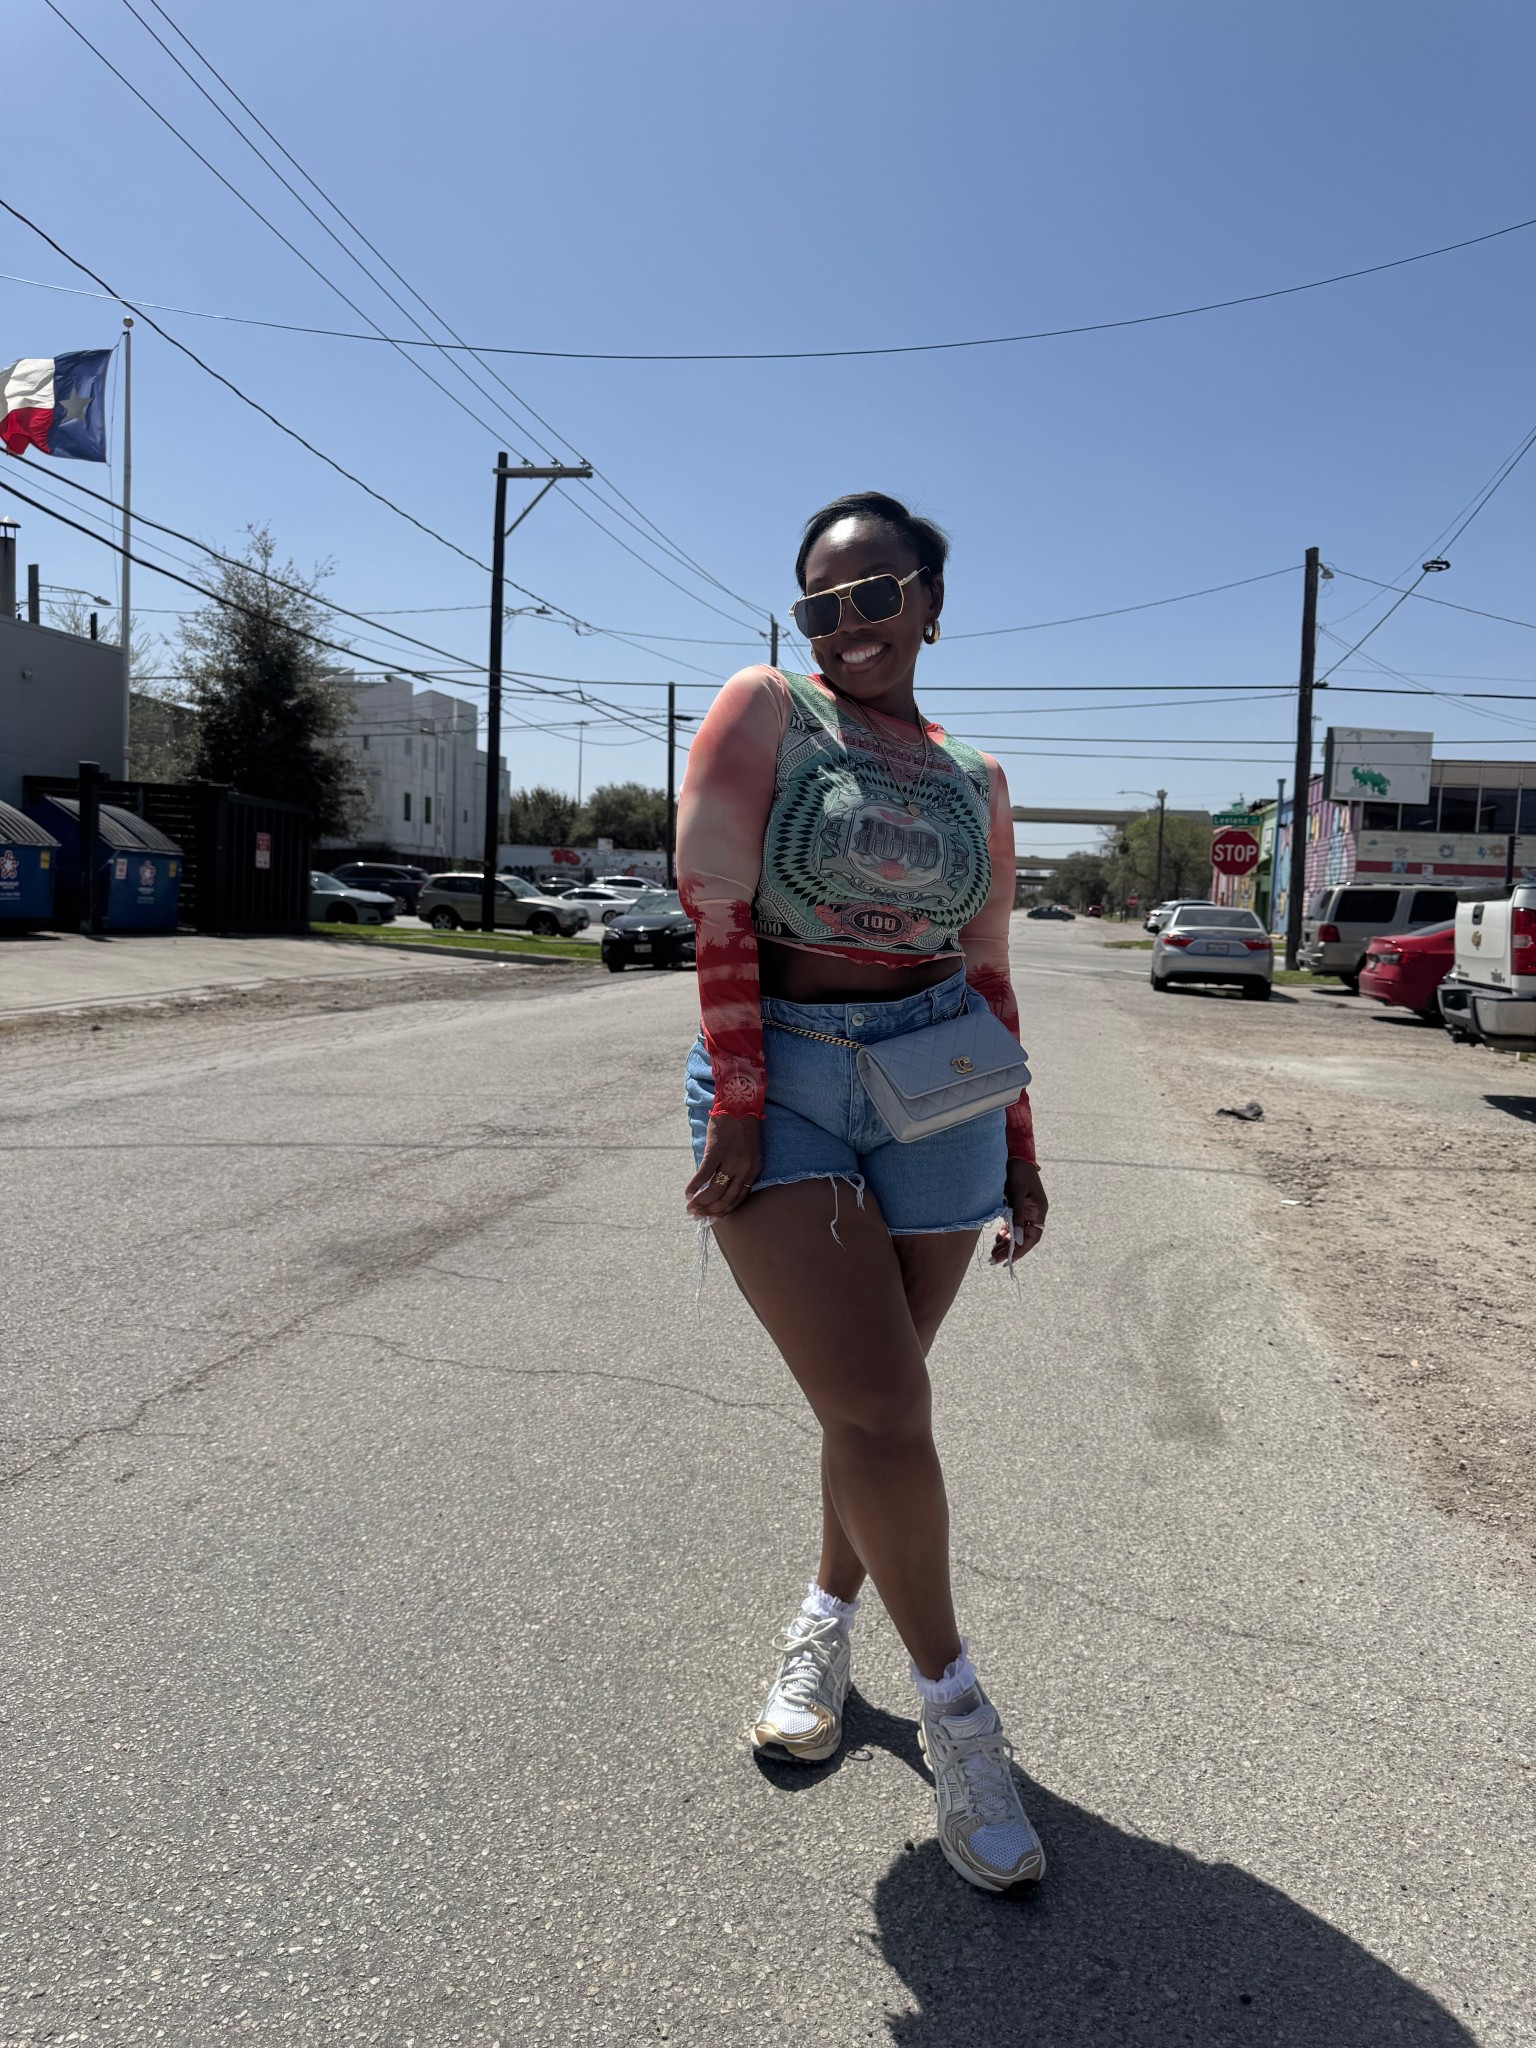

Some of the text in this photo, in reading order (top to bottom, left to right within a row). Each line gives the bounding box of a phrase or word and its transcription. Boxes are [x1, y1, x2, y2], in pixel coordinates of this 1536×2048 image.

[1214, 817, 1249, 825] Leeland
[1213, 844, 1257, 862] STOP
[860, 914, 896, 931] 100
